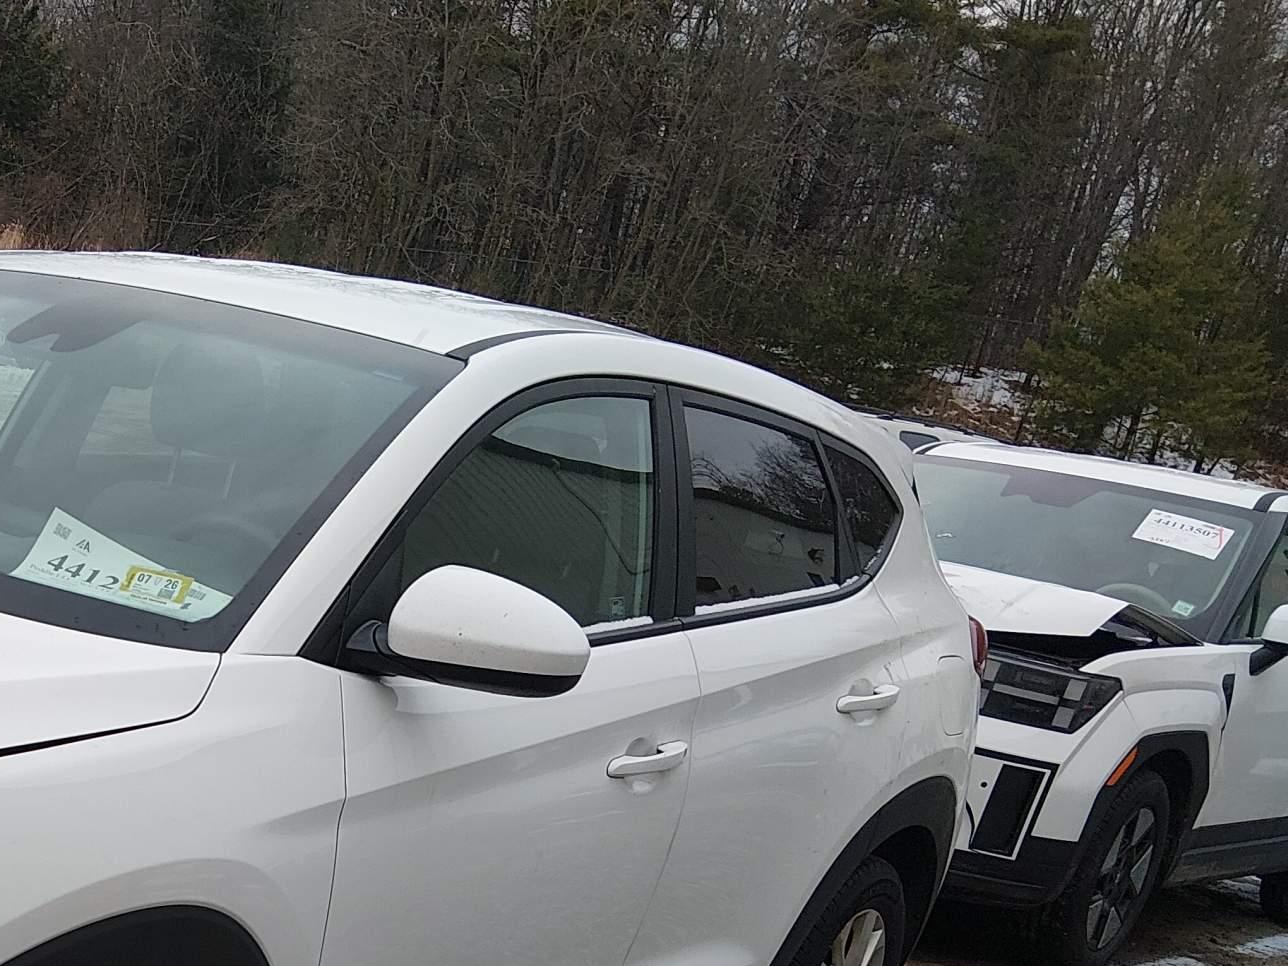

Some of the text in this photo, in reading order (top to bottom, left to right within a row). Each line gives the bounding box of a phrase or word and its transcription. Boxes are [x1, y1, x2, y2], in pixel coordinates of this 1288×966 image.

[1153, 518, 1220, 539] 44113507
[137, 573, 152, 584] 07
[164, 579, 179, 590] 26
